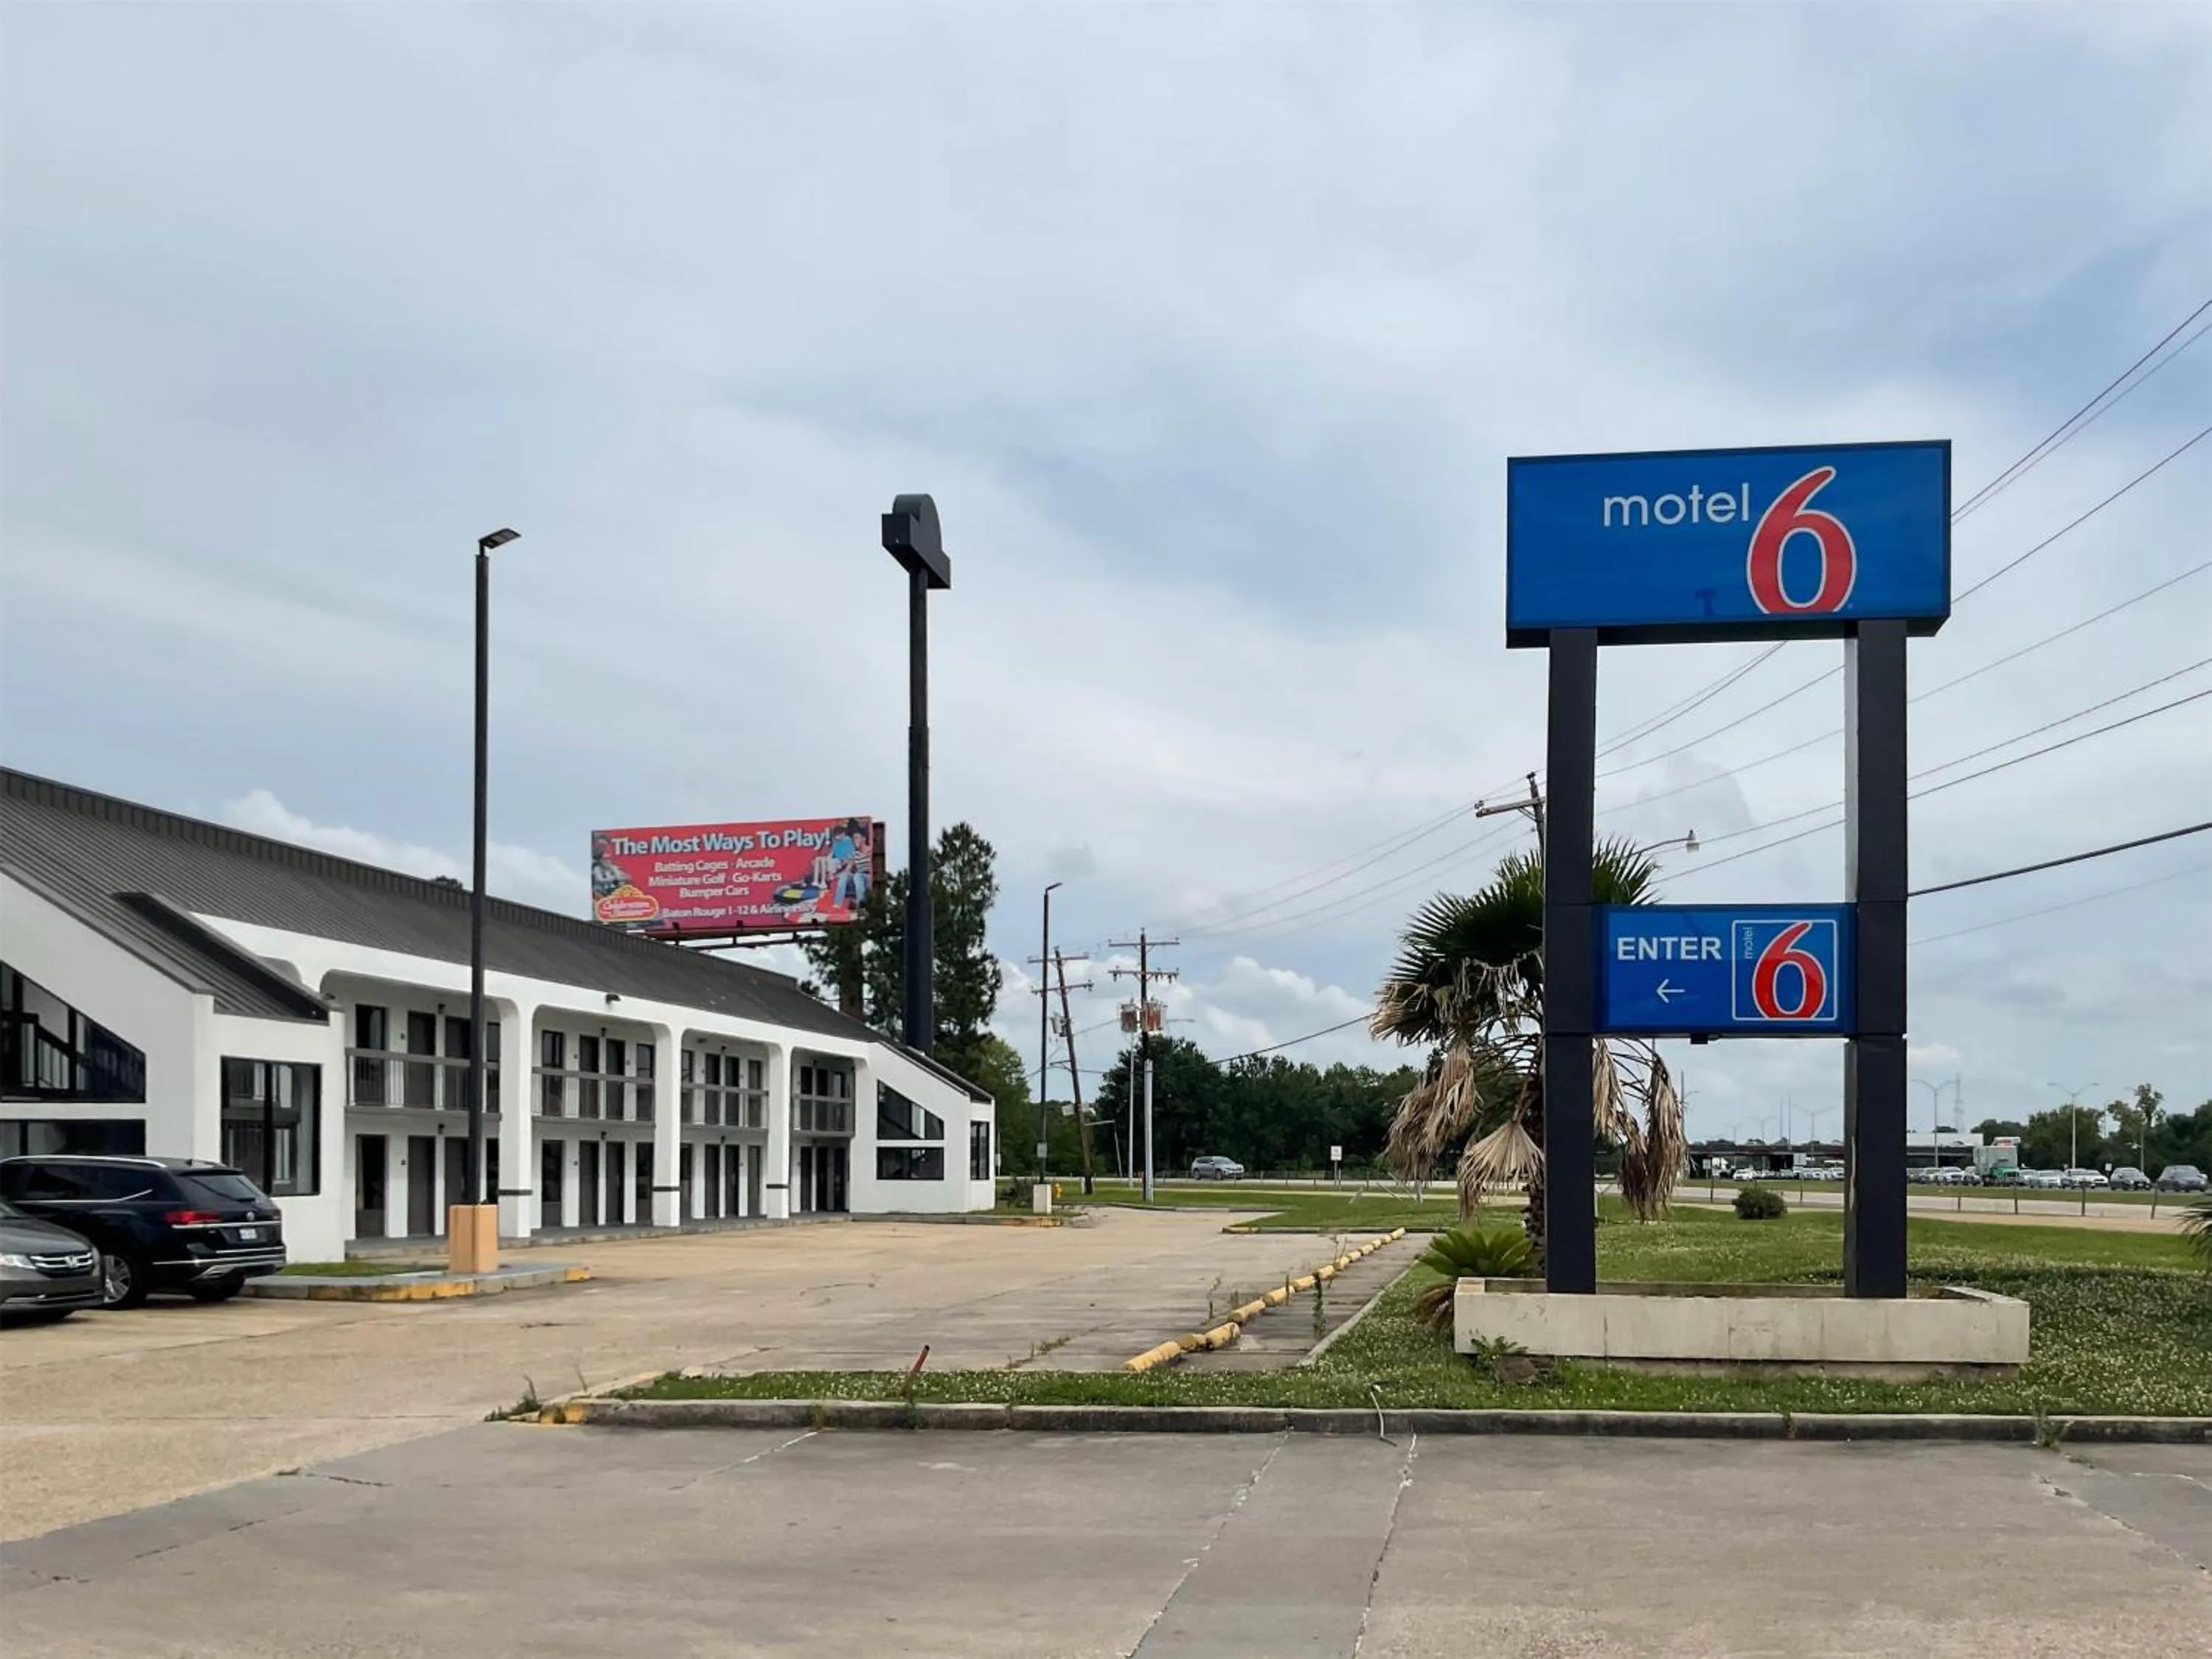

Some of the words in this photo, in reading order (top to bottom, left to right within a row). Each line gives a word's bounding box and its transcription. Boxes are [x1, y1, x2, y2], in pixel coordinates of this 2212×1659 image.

[1604, 483, 1750, 526] motel
[1746, 465, 1857, 614] 6
[612, 838, 648, 855] The
[650, 835, 700, 853] Most
[701, 832, 754, 854] Ways
[756, 830, 779, 848] To
[782, 827, 831, 849] Play!
[653, 861, 695, 873] Batting
[695, 860, 728, 872] Cages
[736, 856, 775, 868] Arcade
[648, 875, 700, 886] Miniature
[702, 872, 726, 884] Golf
[732, 872, 782, 883] Go-Karts
[679, 887, 724, 900] Bumper
[725, 885, 749, 896] Cars
[692, 905, 726, 918] Rouge
[1616, 936, 1722, 961] ENTER
[1745, 926, 1753, 959] motel
[1751, 920, 1827, 1019] 6
